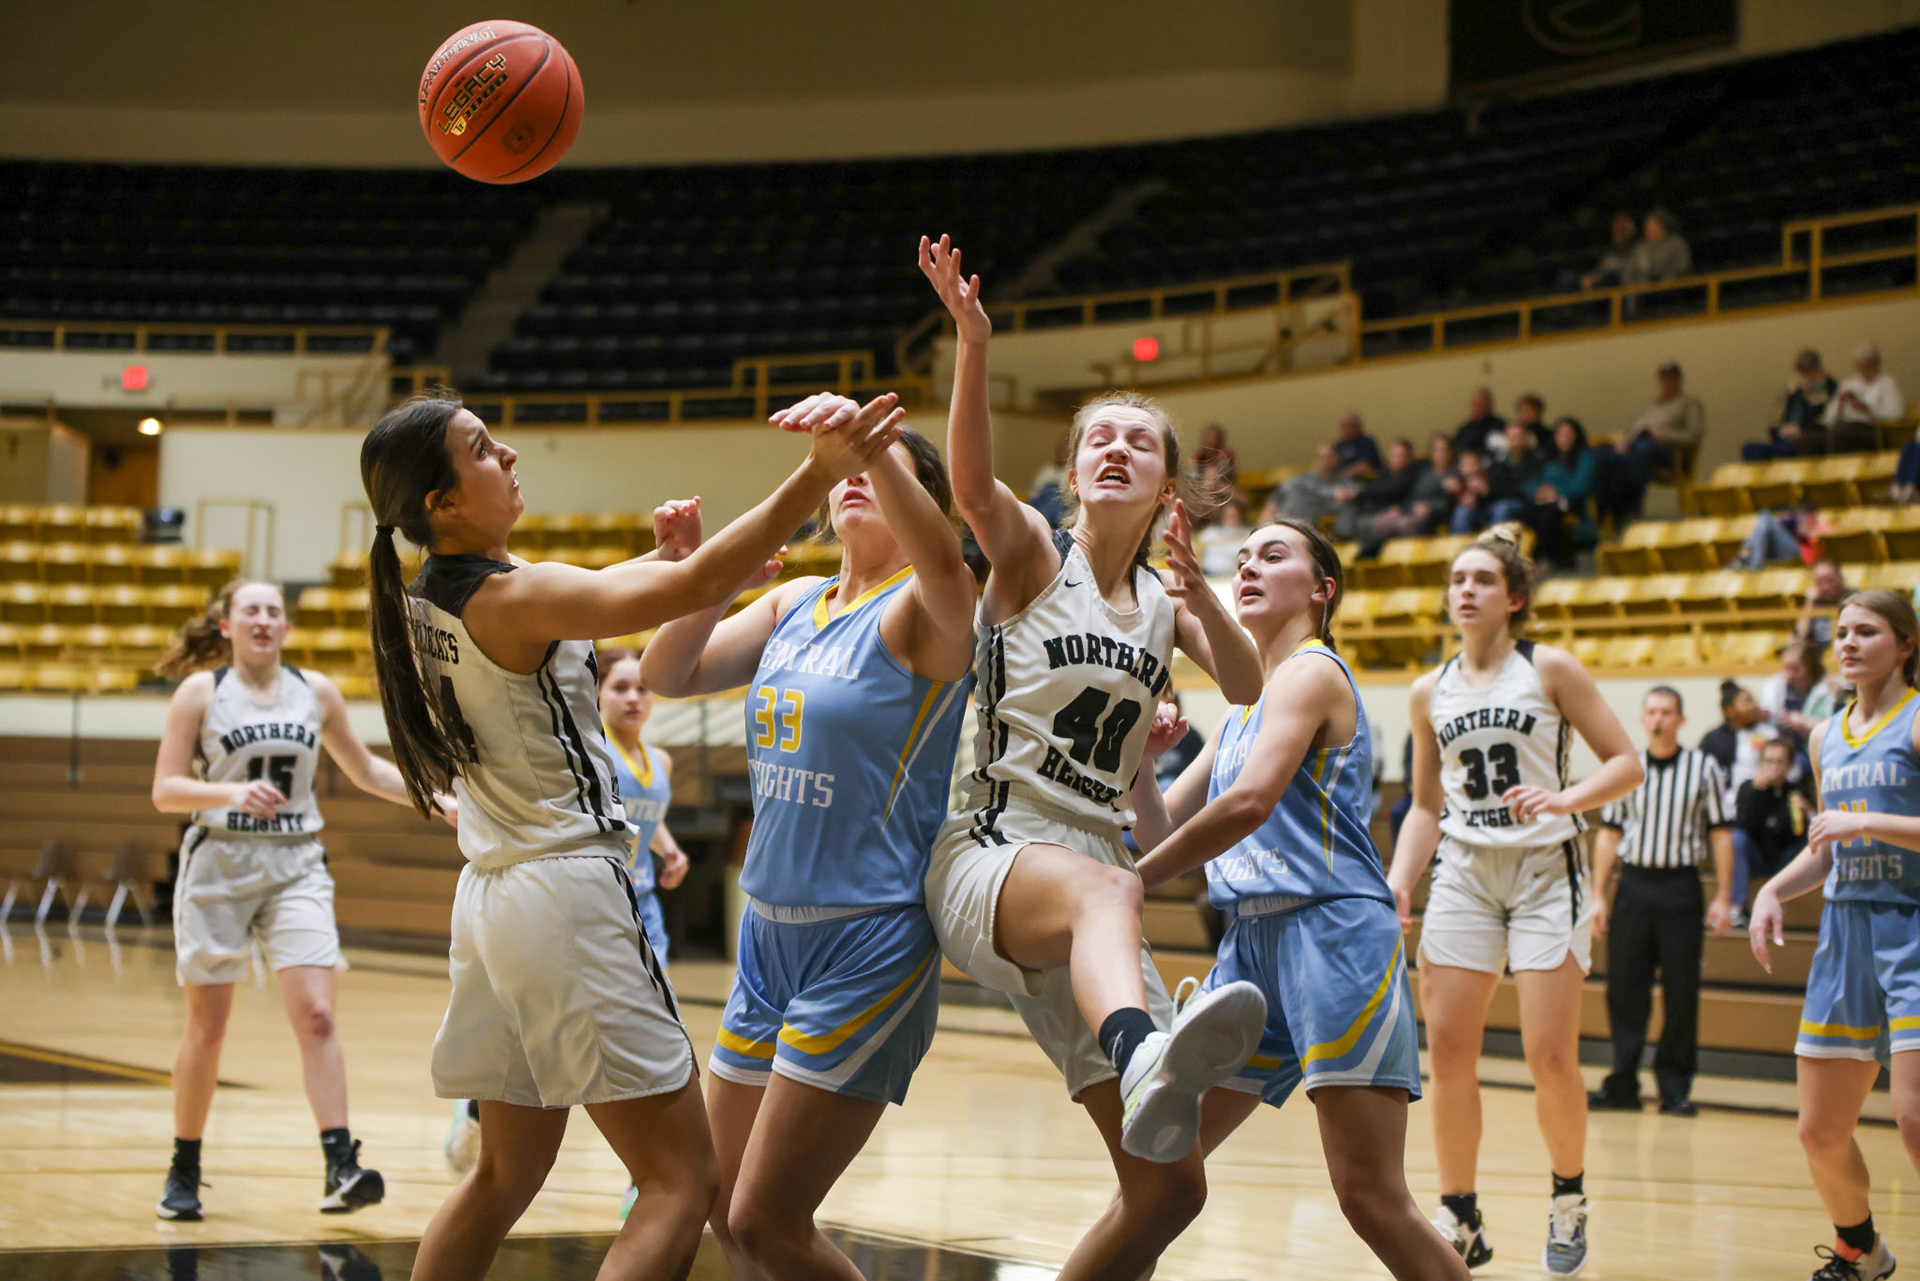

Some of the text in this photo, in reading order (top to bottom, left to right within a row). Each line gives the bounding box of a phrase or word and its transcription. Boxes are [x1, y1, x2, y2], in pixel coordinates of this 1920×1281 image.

[420, 26, 496, 111] SPALDING
[437, 53, 507, 135] LEGACY
[463, 72, 509, 119] 1000
[759, 638, 860, 681] ENRAL
[755, 685, 805, 754] 33
[1052, 686, 1142, 774] 40
[1439, 707, 1537, 749] NORTHERN
[247, 755, 298, 805] 15
[748, 759, 835, 808] IGHTS
[1458, 743, 1521, 801] 33
[1821, 761, 1907, 793] ENTRAL
[1834, 854, 1904, 882] IGHTS
